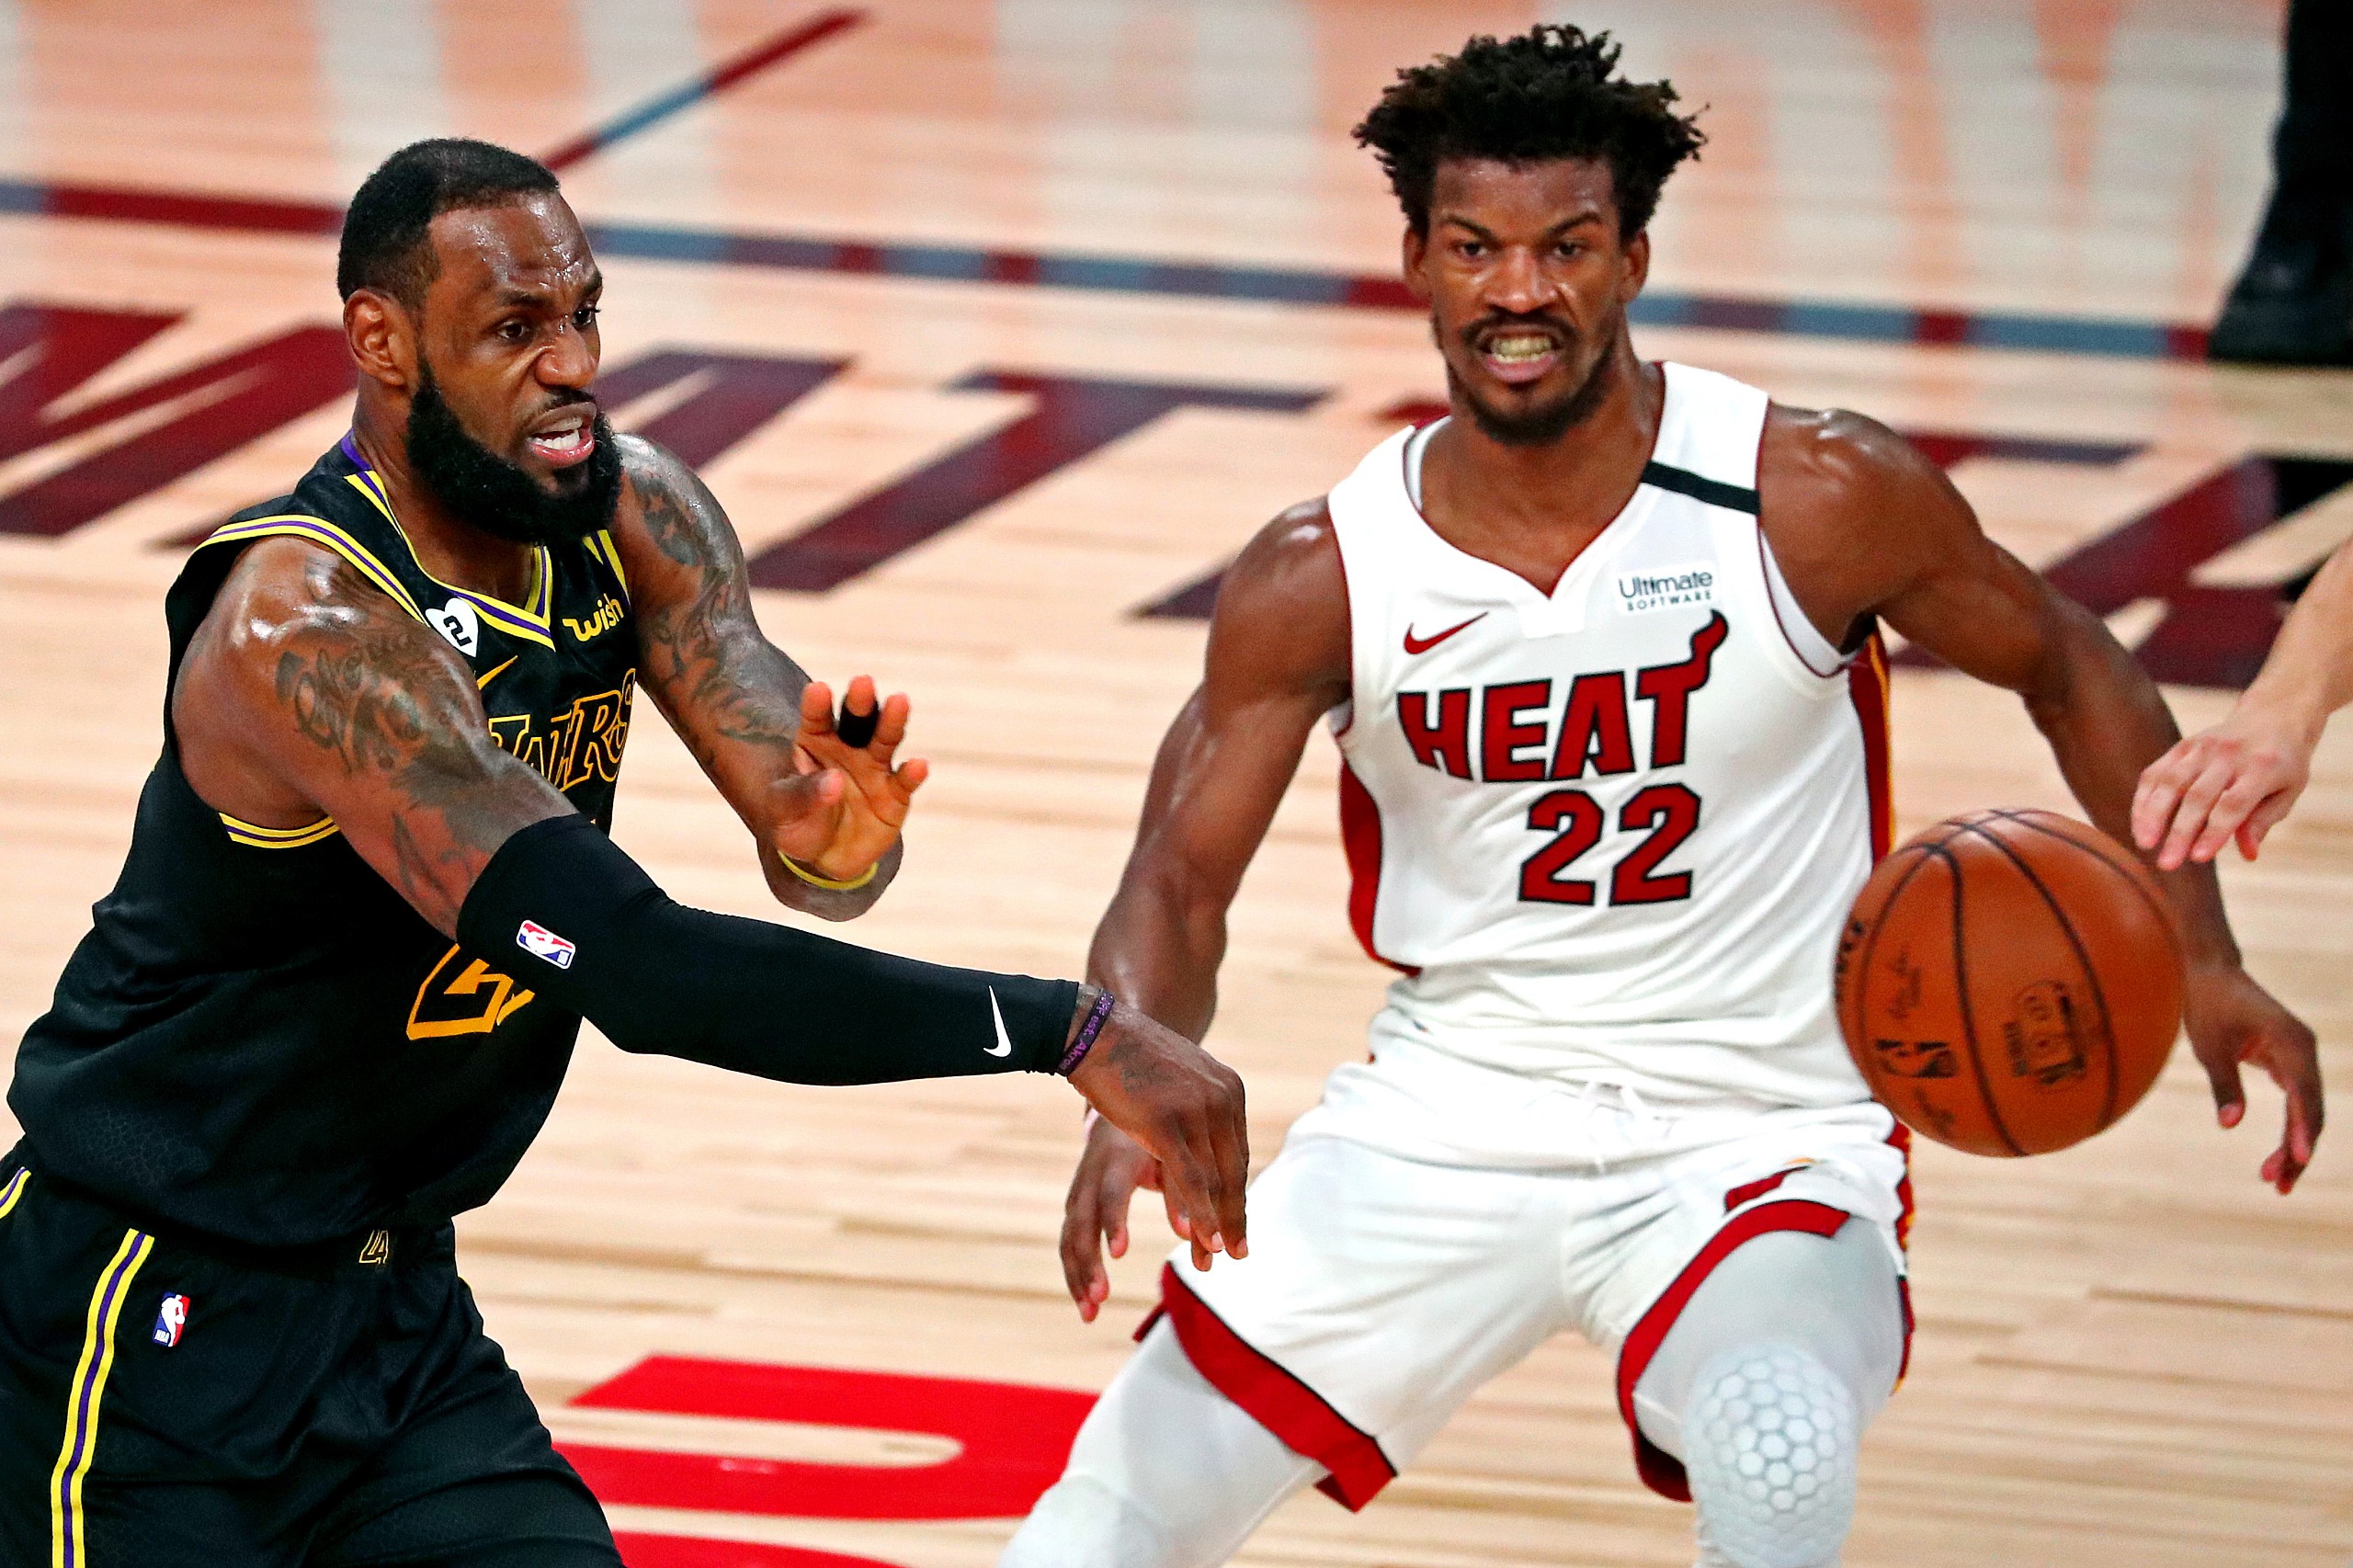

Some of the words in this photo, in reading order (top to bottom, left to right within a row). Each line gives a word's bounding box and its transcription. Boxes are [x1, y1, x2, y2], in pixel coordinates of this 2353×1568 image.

[1618, 571, 1712, 598] Ultimate
[1626, 589, 1711, 611] SOFTWARE
[443, 614, 472, 647] 2
[562, 592, 624, 642] wish
[1396, 608, 1729, 784] HEAT
[1518, 781, 1702, 907] 22
